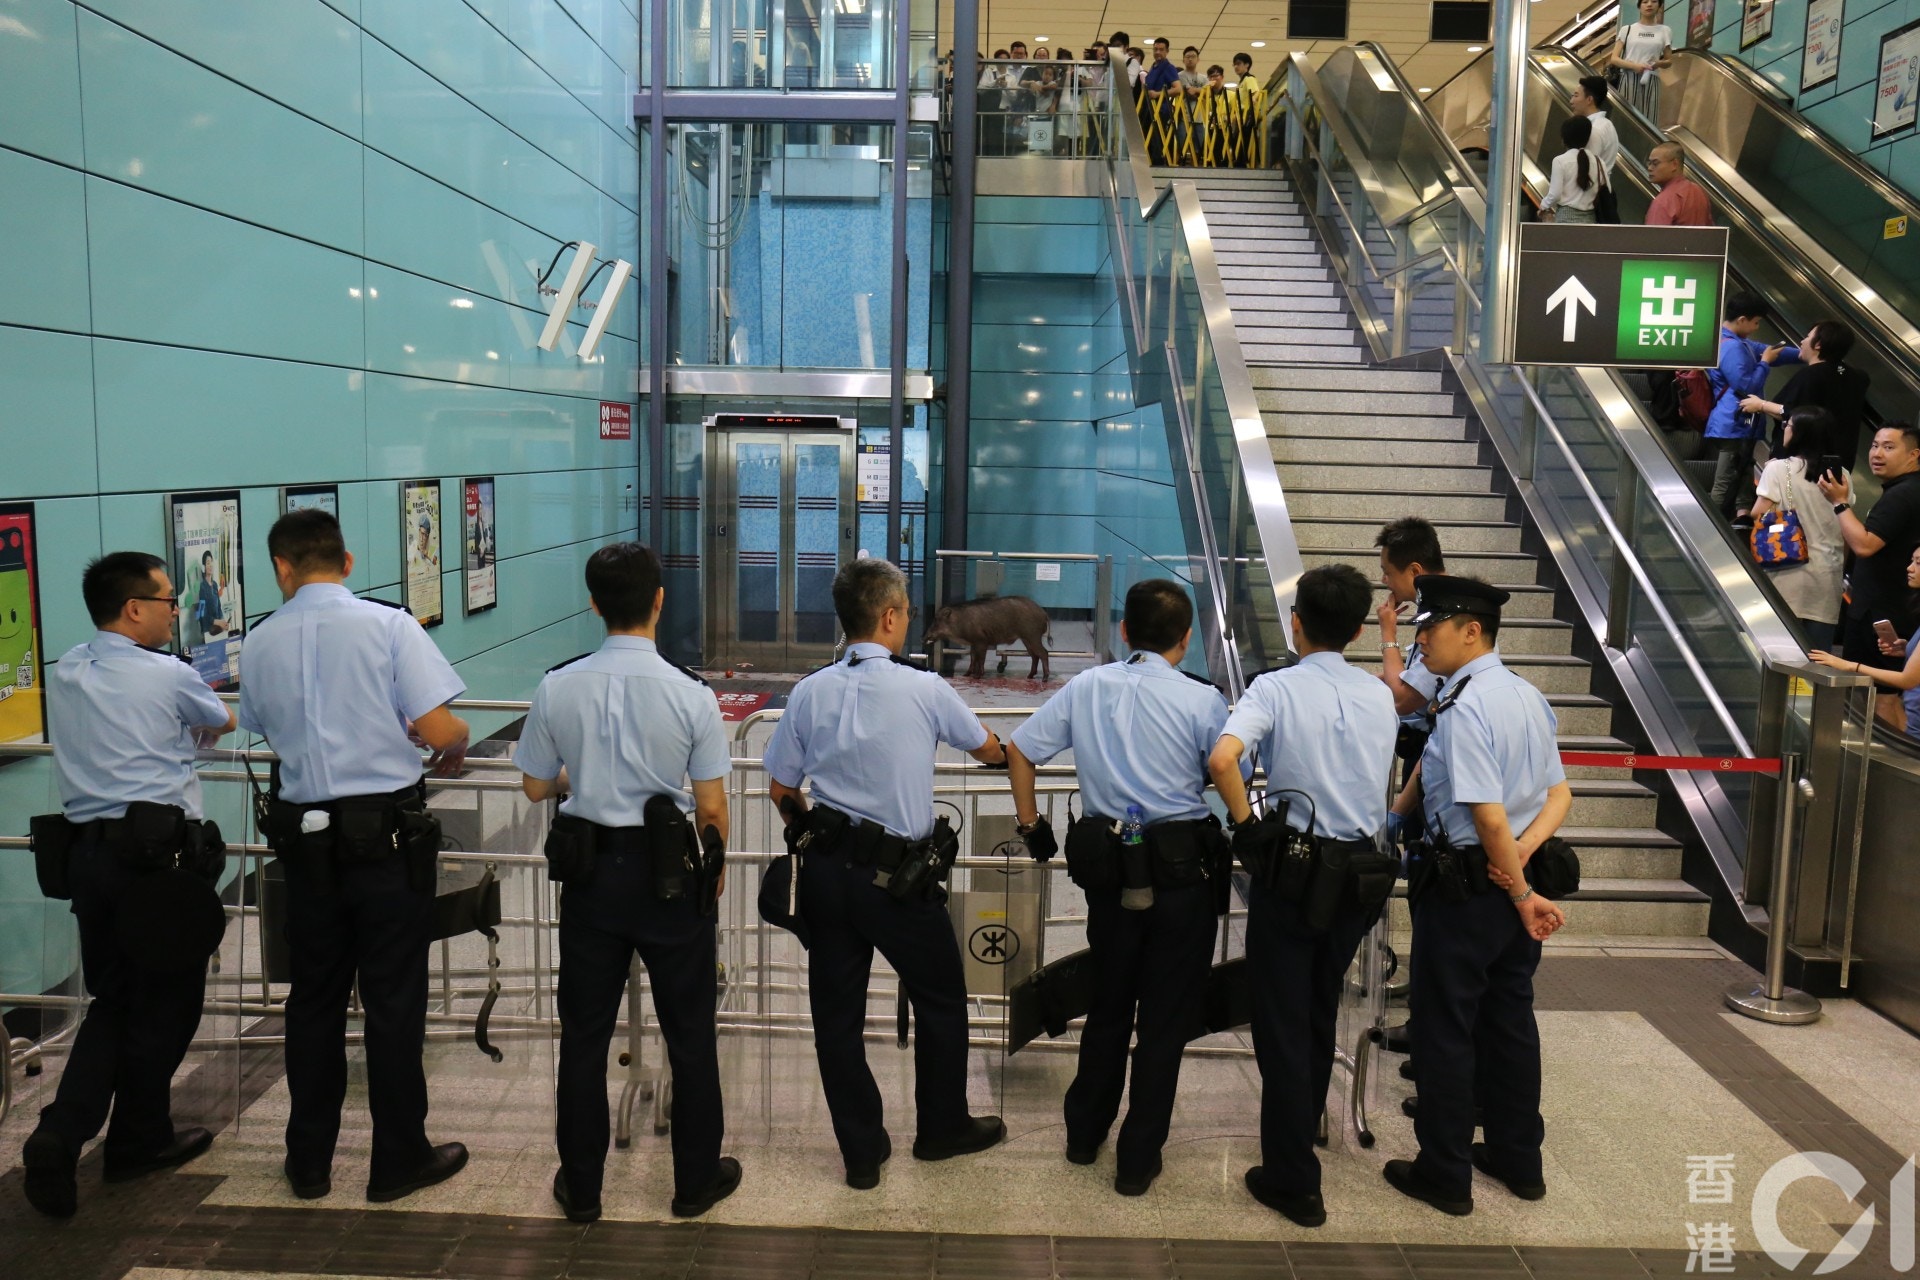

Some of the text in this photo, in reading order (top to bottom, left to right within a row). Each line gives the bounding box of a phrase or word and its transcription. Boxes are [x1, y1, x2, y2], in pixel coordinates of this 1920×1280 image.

[1879, 84, 1899, 99] 7500
[1640, 275, 1697, 326] 出
[1638, 327, 1693, 347] EXIT
